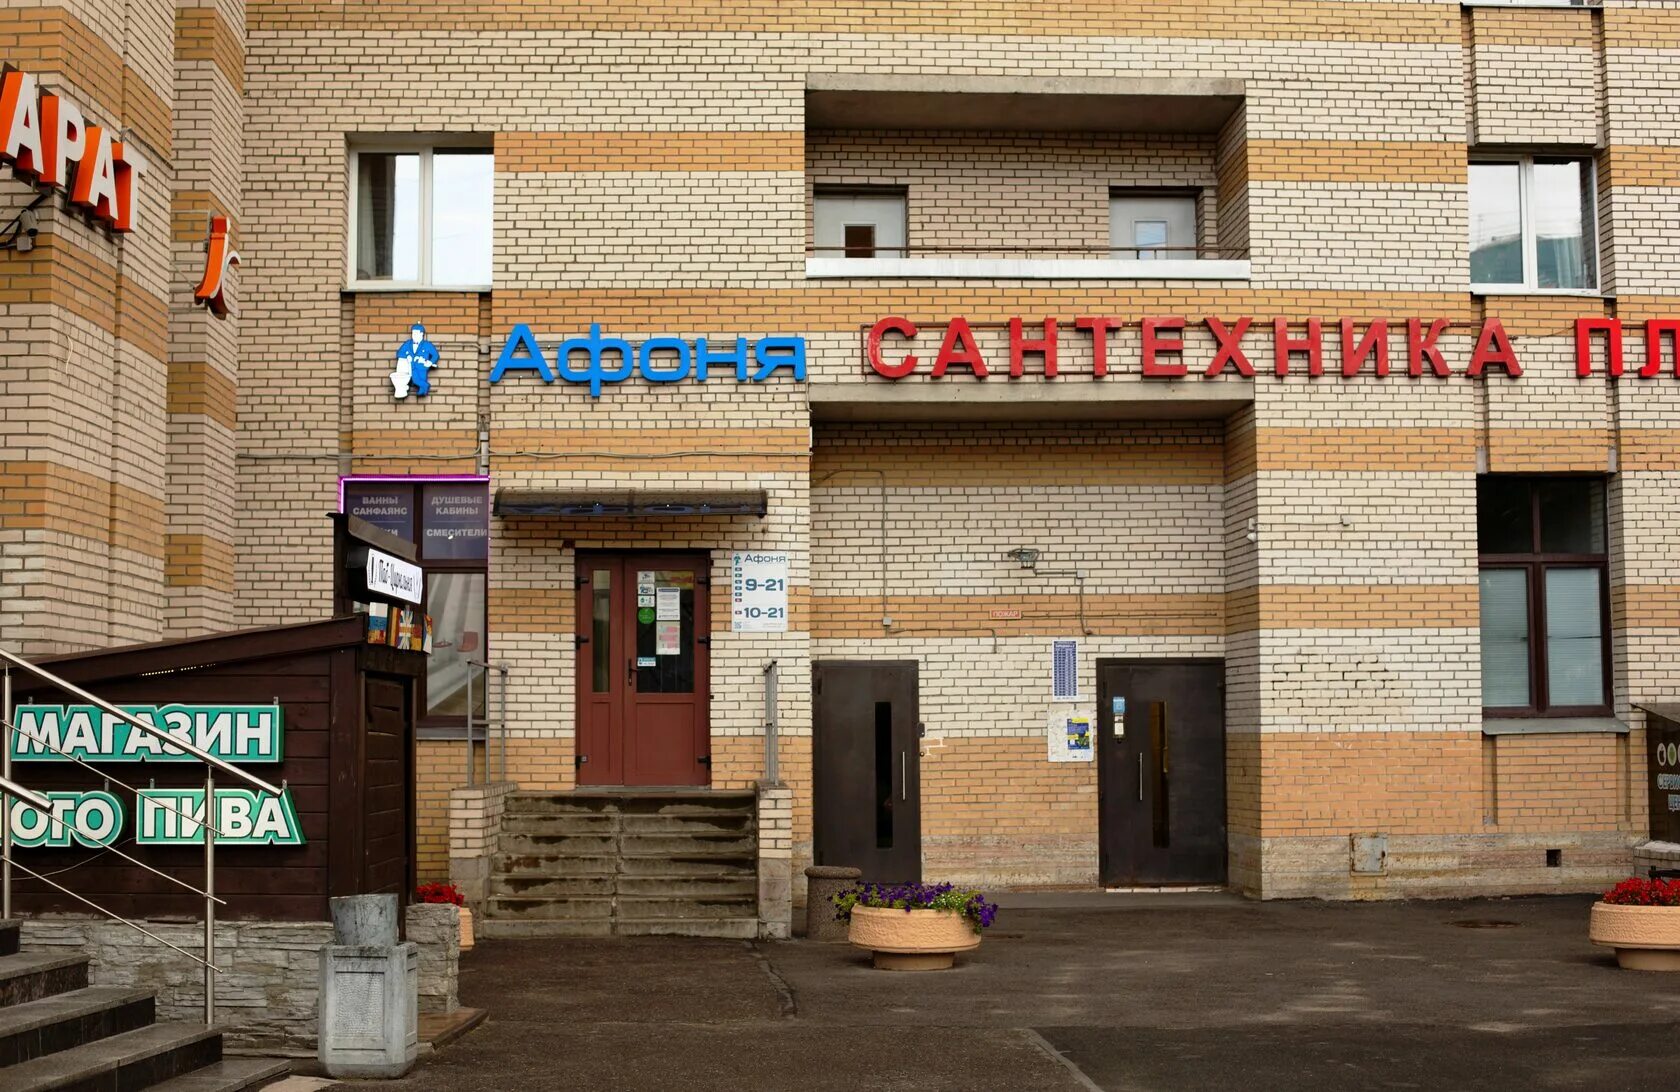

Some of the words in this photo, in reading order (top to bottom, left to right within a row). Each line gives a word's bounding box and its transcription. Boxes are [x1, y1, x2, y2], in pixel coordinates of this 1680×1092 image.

[866, 316, 1524, 378] САНТЕХНИКА
[488, 322, 807, 397] Афоня
[362, 496, 399, 505] ВАННЫ
[431, 496, 483, 505] ДУШЕВЫЕ
[353, 507, 408, 515] САНФАЯНС
[435, 507, 479, 515] КАБИНЫ
[426, 529, 488, 537] СМЕСИТЕЛИ
[744, 554, 786, 564] Афоня
[745, 578, 784, 591] 9-21
[744, 607, 784, 618] 10-21
[992, 610, 1019, 618] ПОЖАР
[15, 710, 273, 756] МАГАЗИН
[0, 796, 115, 841] ОГО
[142, 796, 292, 841] ПИВА
